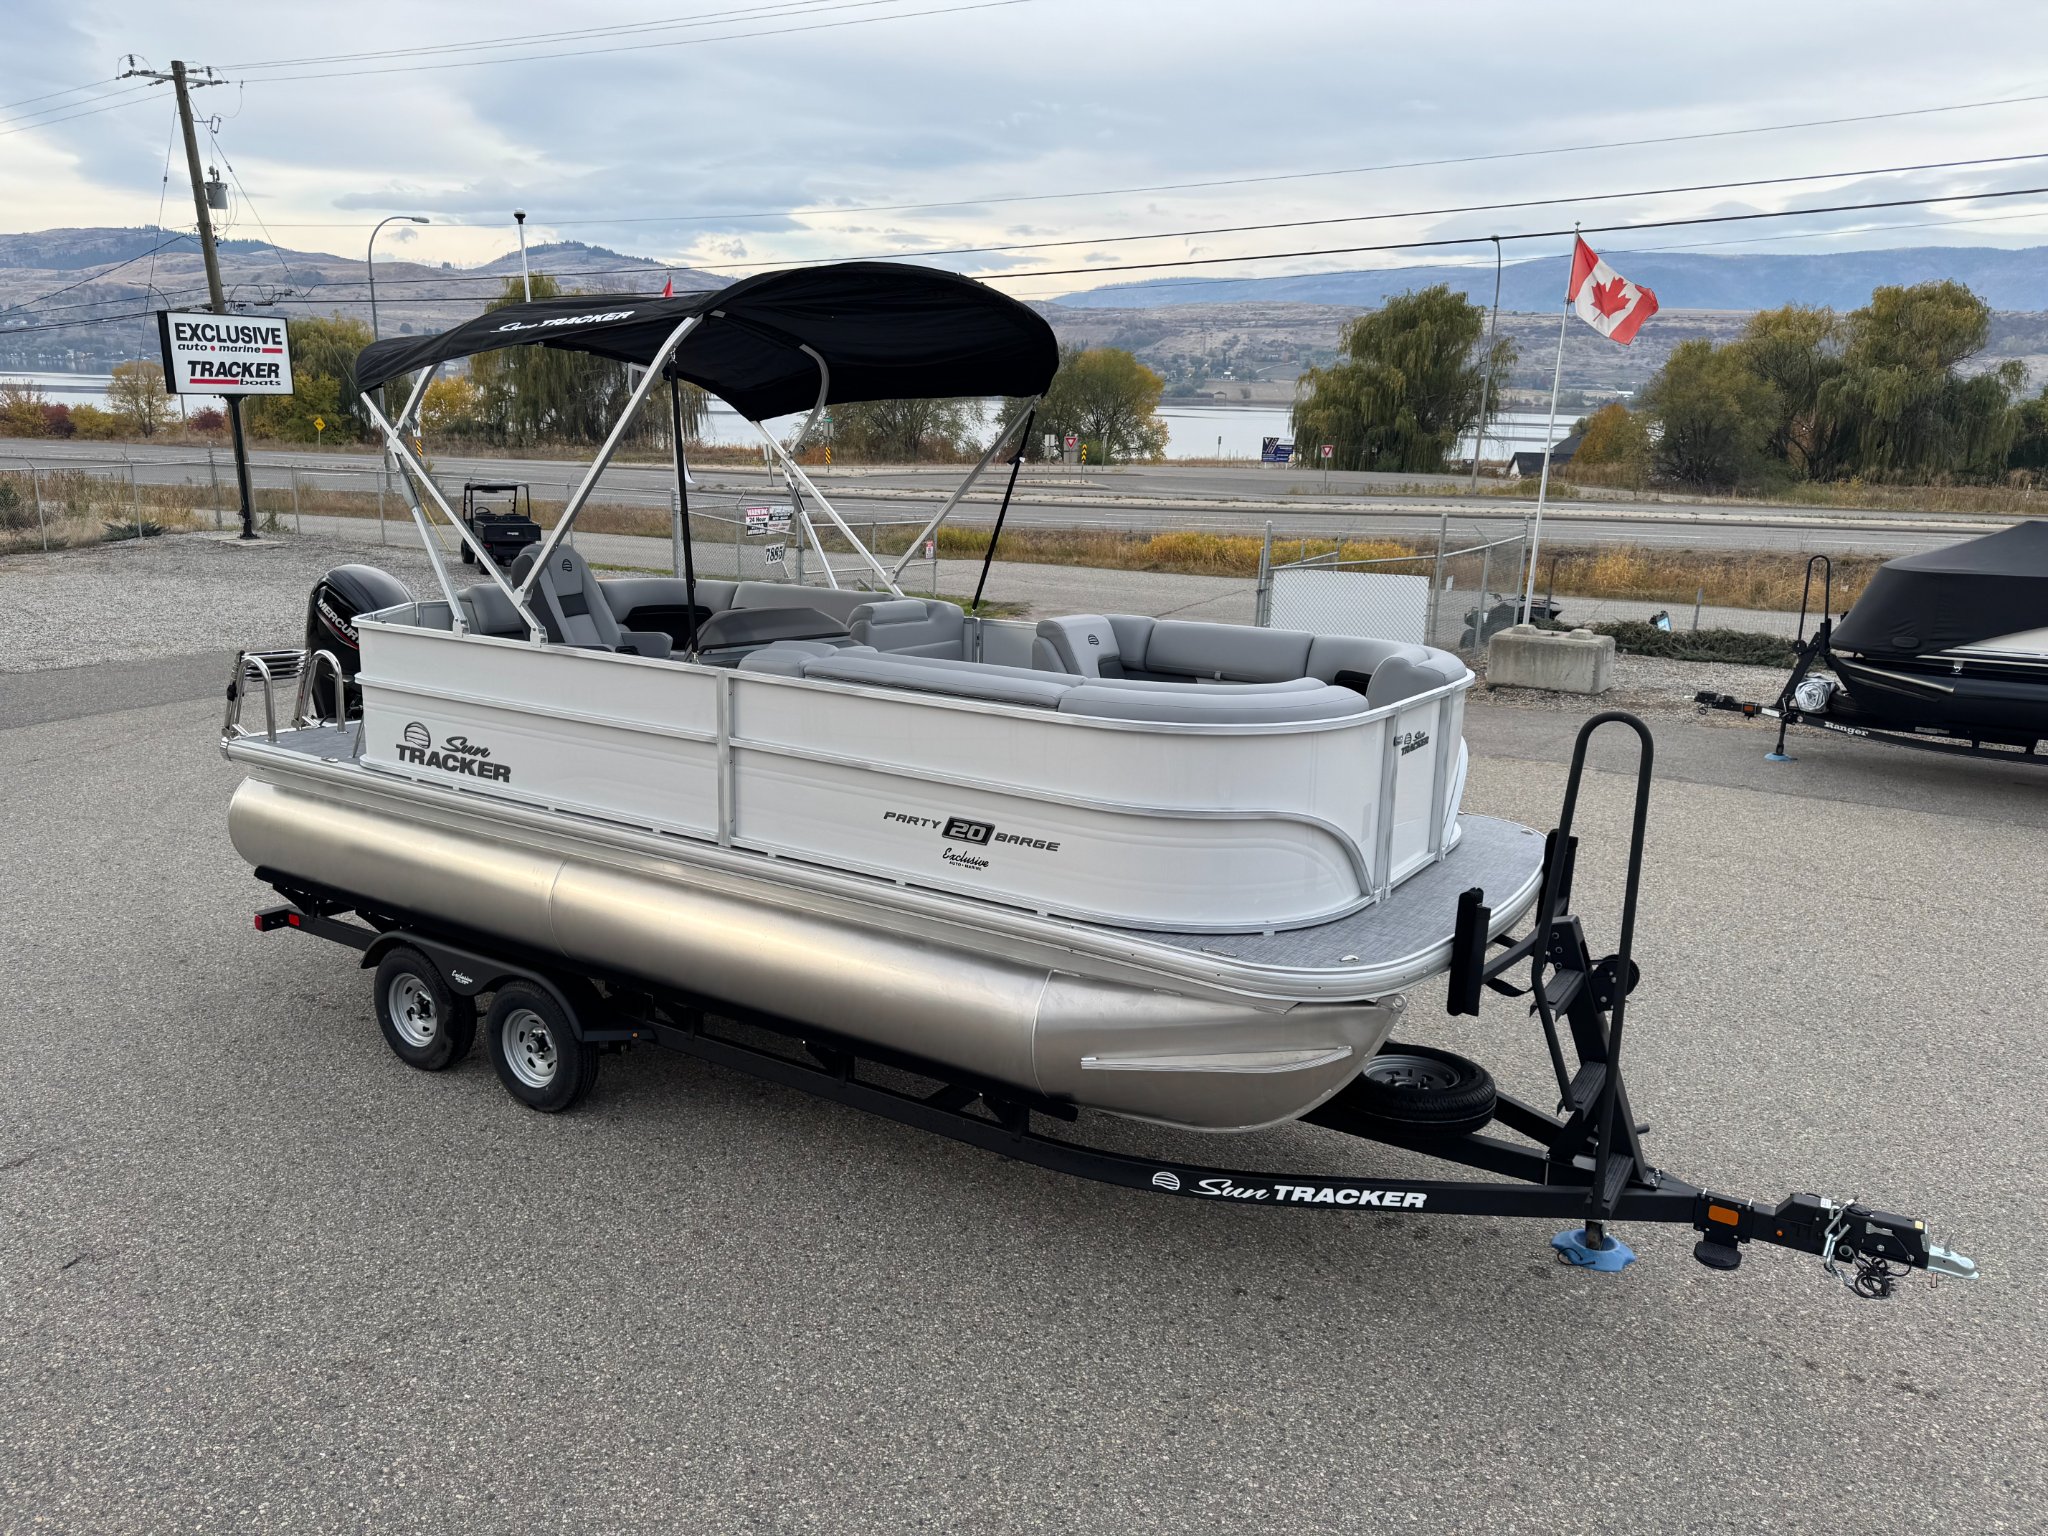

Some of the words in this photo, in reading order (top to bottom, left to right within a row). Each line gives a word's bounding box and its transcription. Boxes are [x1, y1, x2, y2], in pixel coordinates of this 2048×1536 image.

[537, 310, 635, 328] TRACKER
[174, 322, 283, 346] EXCLUSIVE
[177, 343, 208, 351] auto
[218, 345, 261, 353] marine
[187, 360, 280, 379] TRACKER
[239, 378, 281, 386] boats
[317, 598, 360, 644] MERCUR
[1823, 721, 1869, 737] Ranger
[440, 735, 491, 758] Sun
[395, 743, 511, 783] TRACKER
[883, 811, 943, 829] PARTY
[948, 822, 987, 842] 20
[994, 832, 1061, 852] BARGE
[942, 847, 989, 868] Exclusive
[1188, 1178, 1270, 1200] Sun
[1273, 1184, 1428, 1208] TRACKER
